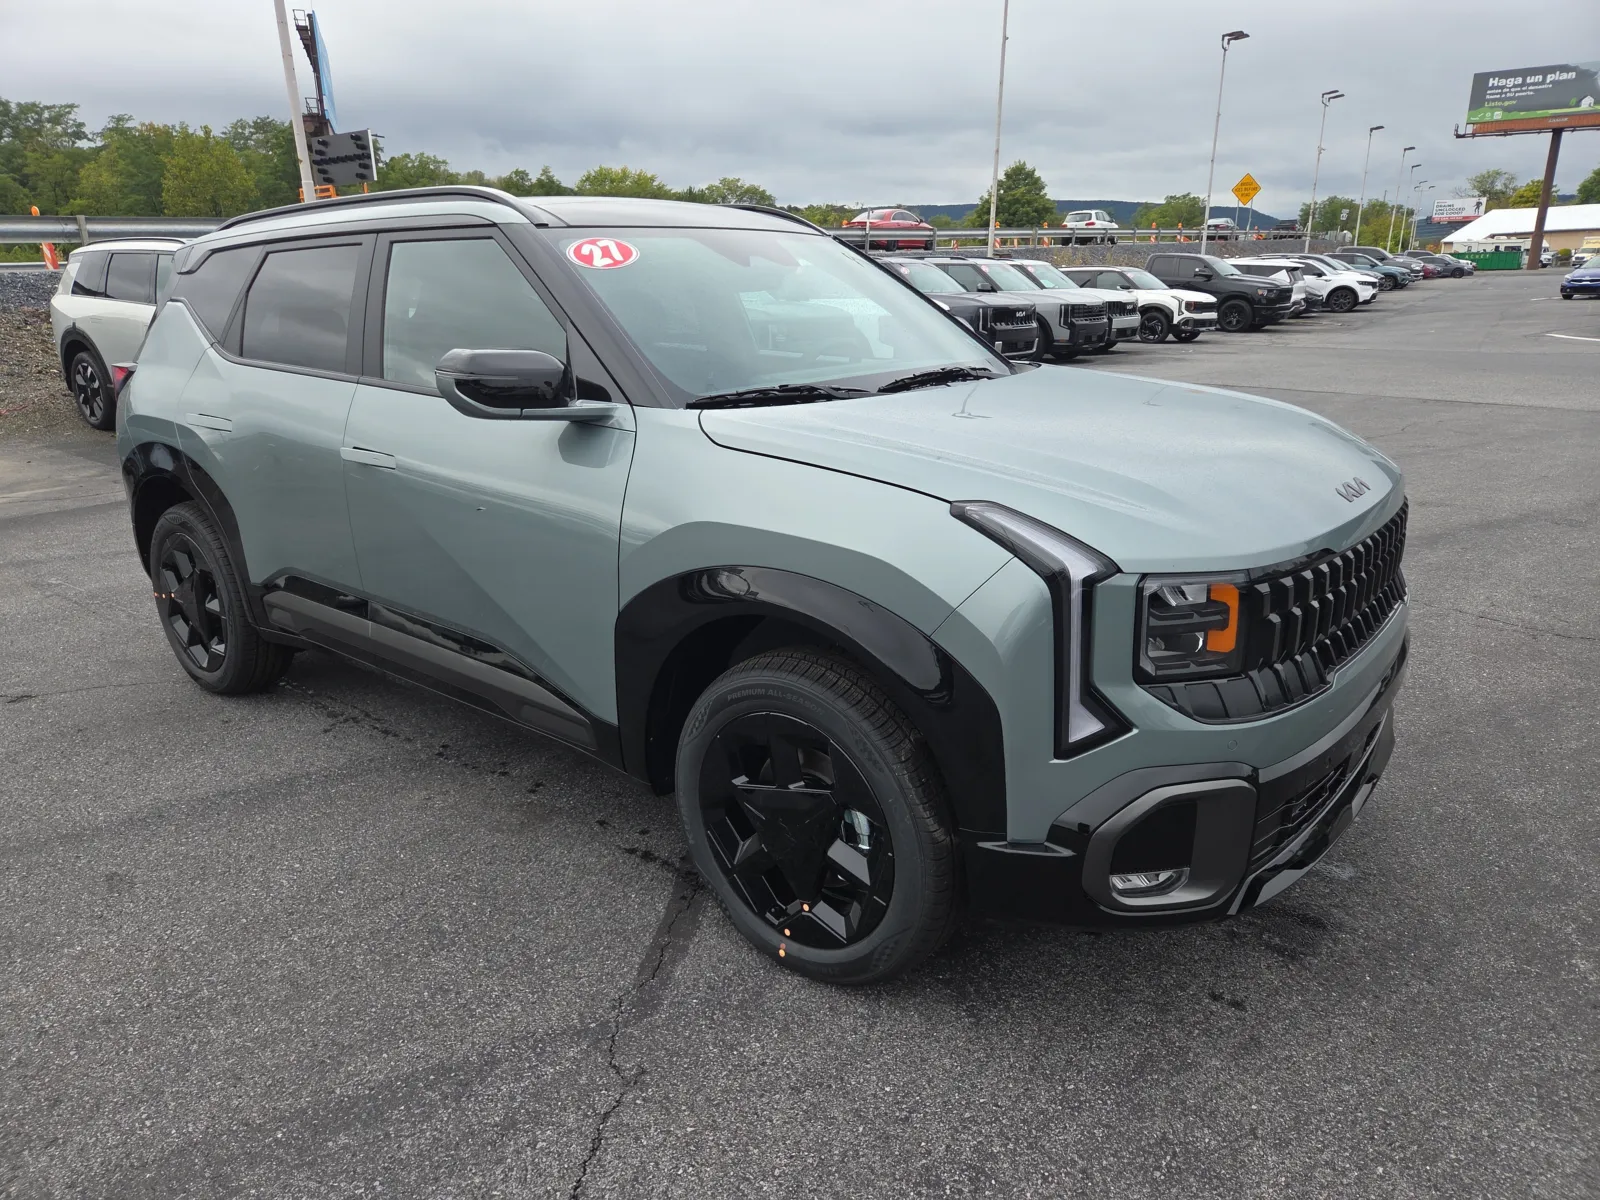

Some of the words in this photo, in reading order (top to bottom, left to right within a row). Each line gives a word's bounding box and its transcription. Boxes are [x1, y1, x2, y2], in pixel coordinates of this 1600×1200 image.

[1488, 76, 1522, 87] Haga
[1527, 74, 1542, 83] un
[1547, 71, 1576, 83] plan
[581, 240, 624, 266] 27
[727, 689, 765, 702] PREMIUM
[767, 690, 826, 716] ALL-SEASON
